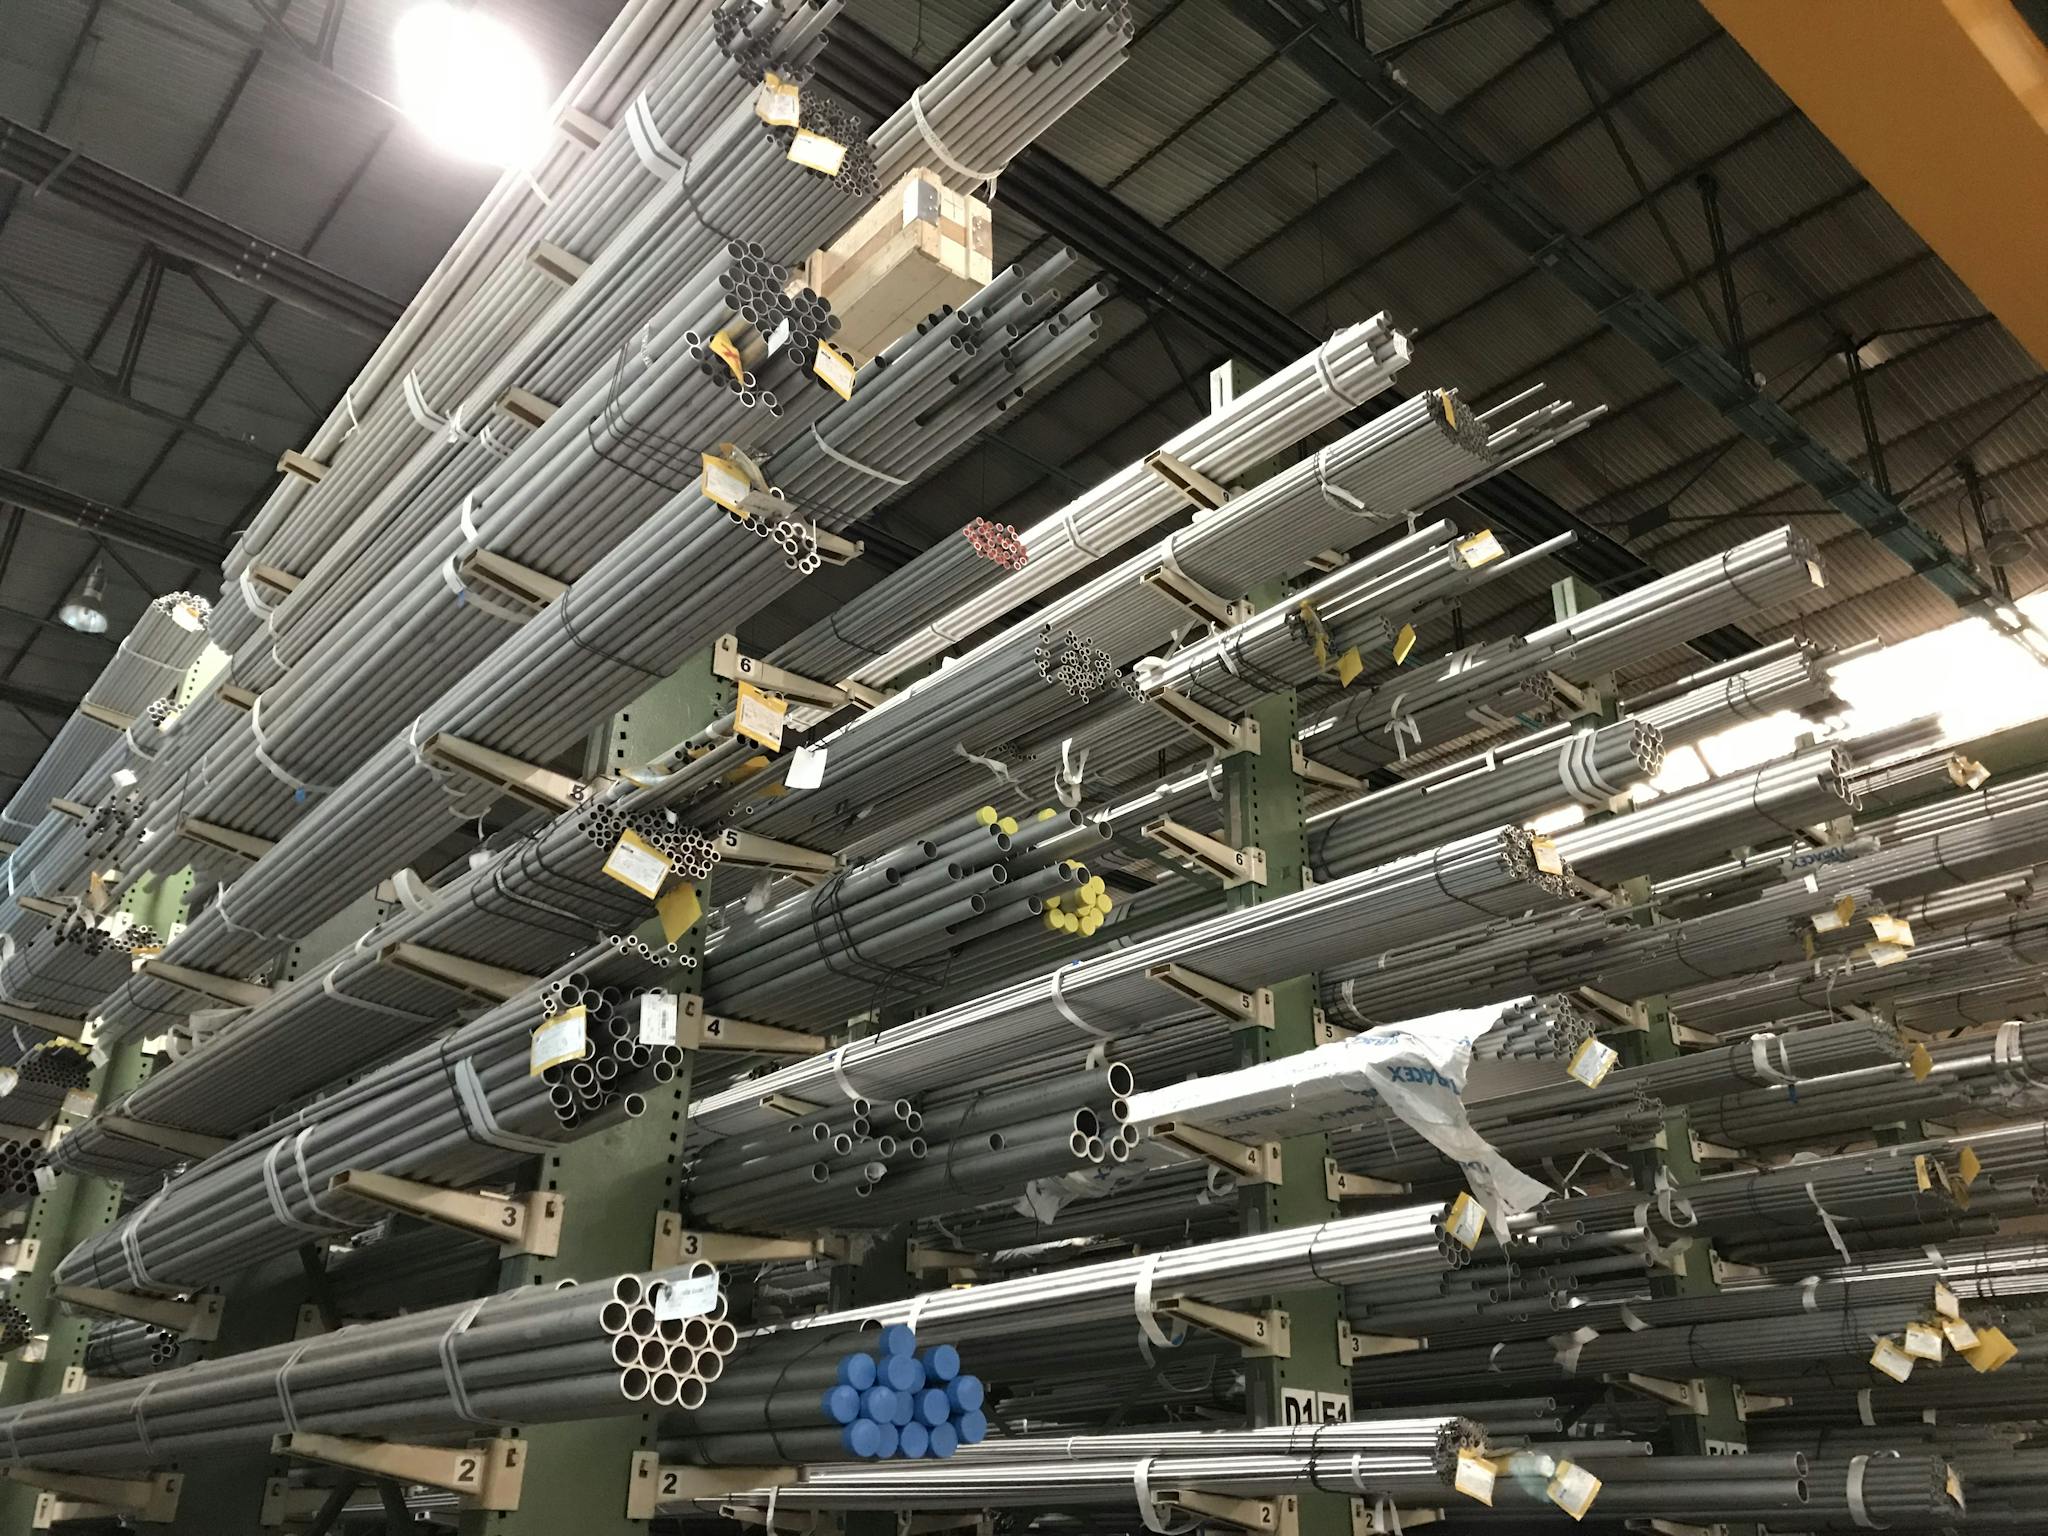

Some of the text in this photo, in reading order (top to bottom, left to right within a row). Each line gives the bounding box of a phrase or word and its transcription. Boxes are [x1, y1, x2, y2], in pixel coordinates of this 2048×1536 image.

[740, 658, 752, 673] 6
[1230, 723, 1238, 735] 7
[1303, 759, 1310, 769] 7
[726, 831, 738, 847] 5
[1236, 853, 1244, 865] 6
[1242, 995, 1250, 1009] 5
[706, 1019, 721, 1037] 4
[1325, 1025, 1333, 1038] 5
[1248, 1150, 1256, 1164] 4
[1338, 1175, 1346, 1189] 4
[501, 1206, 517, 1228] 3
[684, 1235, 698, 1255] 3
[1256, 1321, 1265, 1337] 3
[1352, 1337, 1360, 1352] 3
[1285, 1396, 1313, 1427] D1
[458, 1458, 476, 1483] 2
[662, 1473, 678, 1495] 2
[1262, 1506, 1271, 1523] 2
[1366, 1513, 1374, 1529] 2
